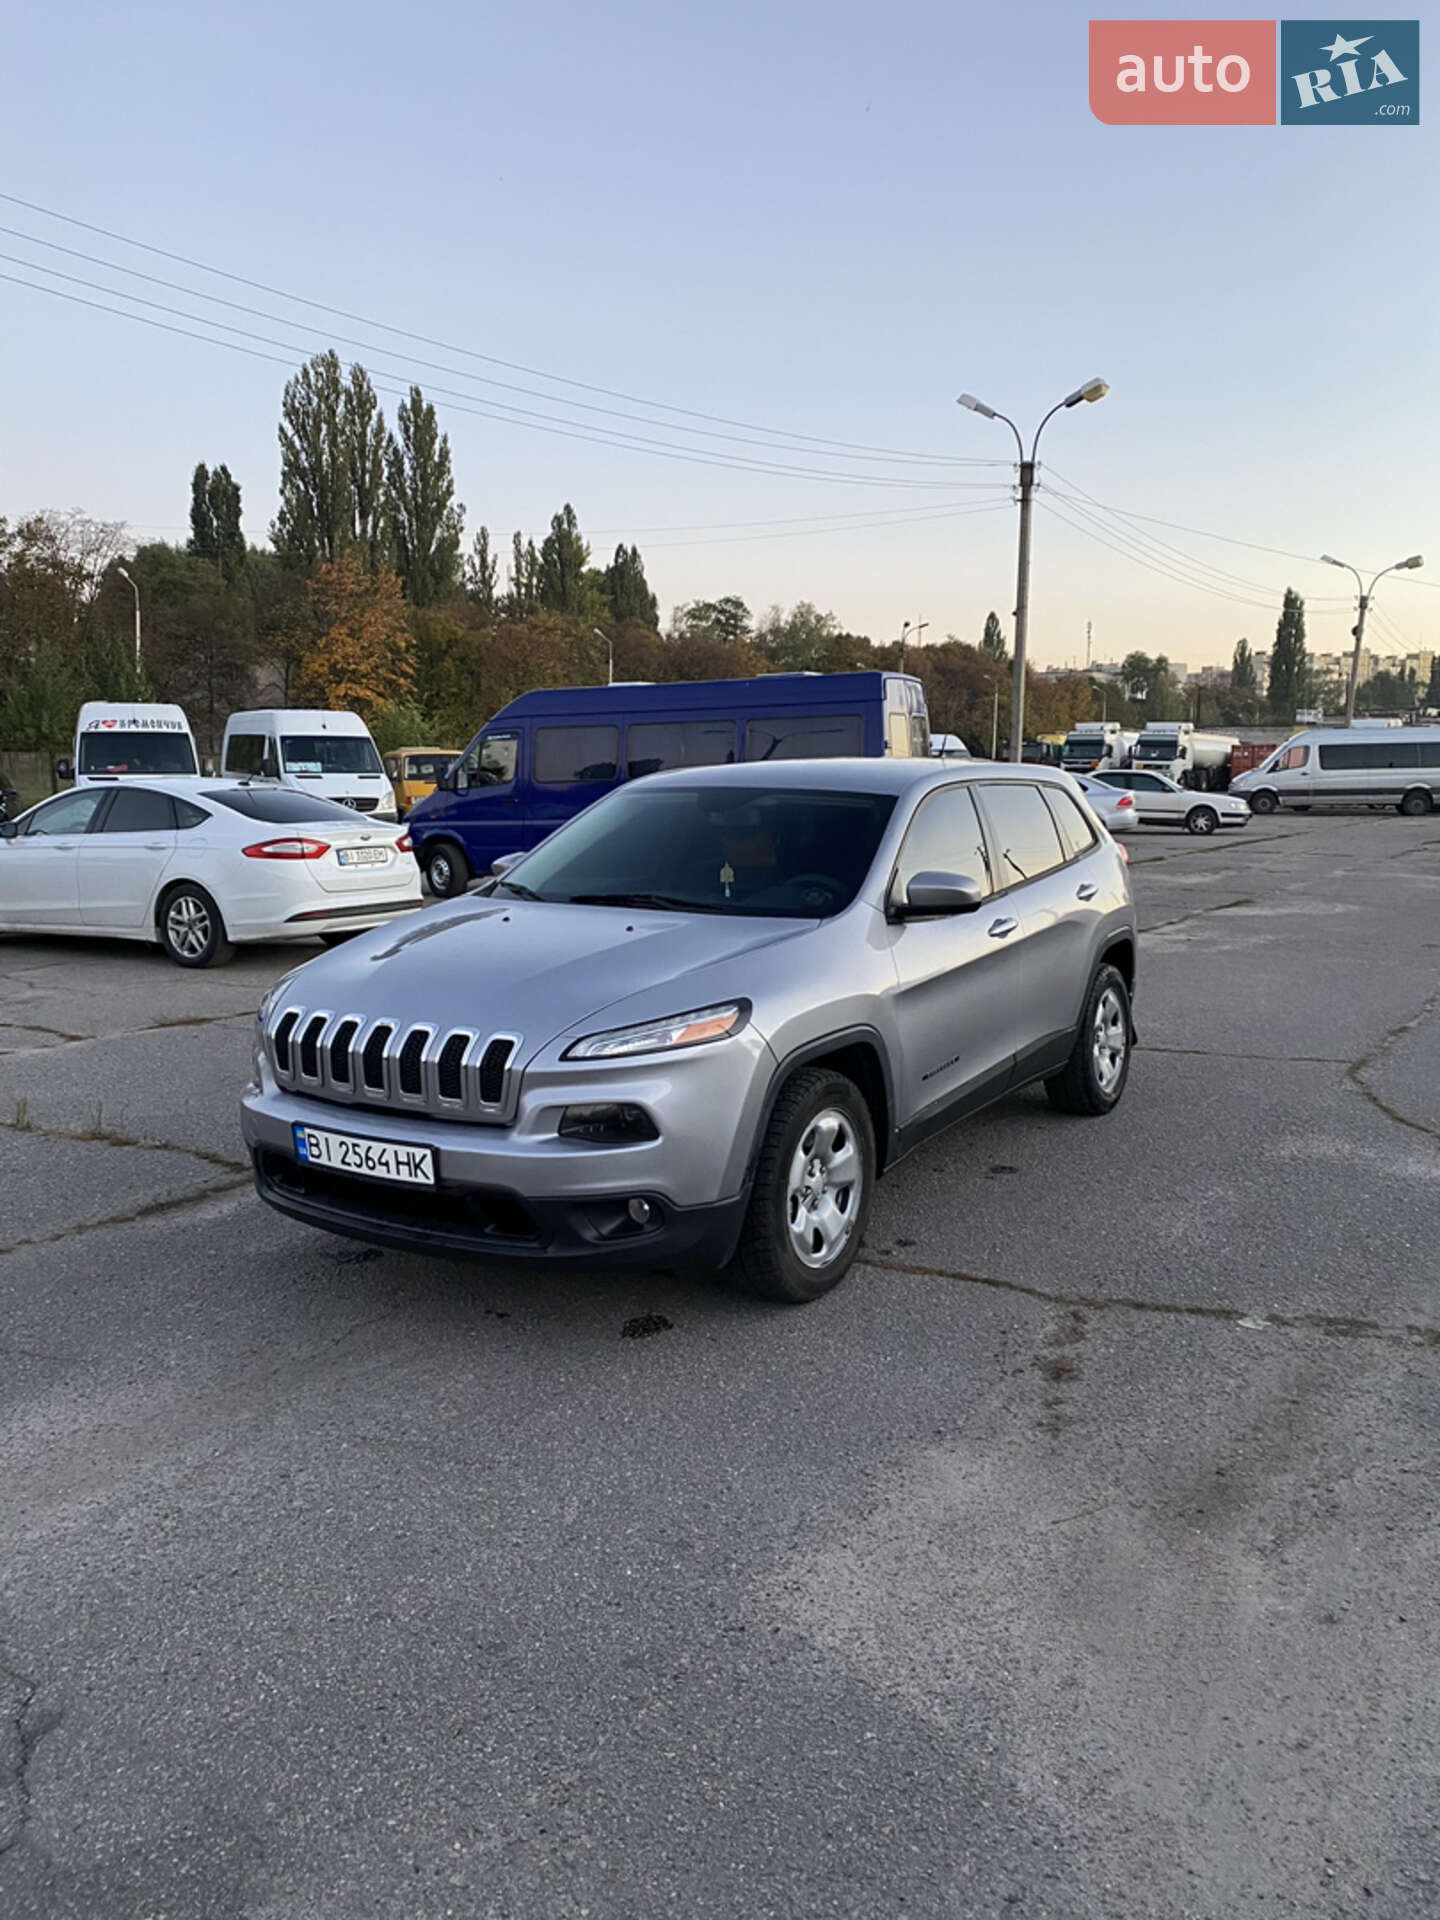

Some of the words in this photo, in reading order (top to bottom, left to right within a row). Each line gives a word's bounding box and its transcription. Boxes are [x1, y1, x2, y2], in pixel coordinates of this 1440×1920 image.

[307, 1132, 331, 1162] BI
[339, 1140, 391, 1174] 2564
[394, 1149, 431, 1181] HK
